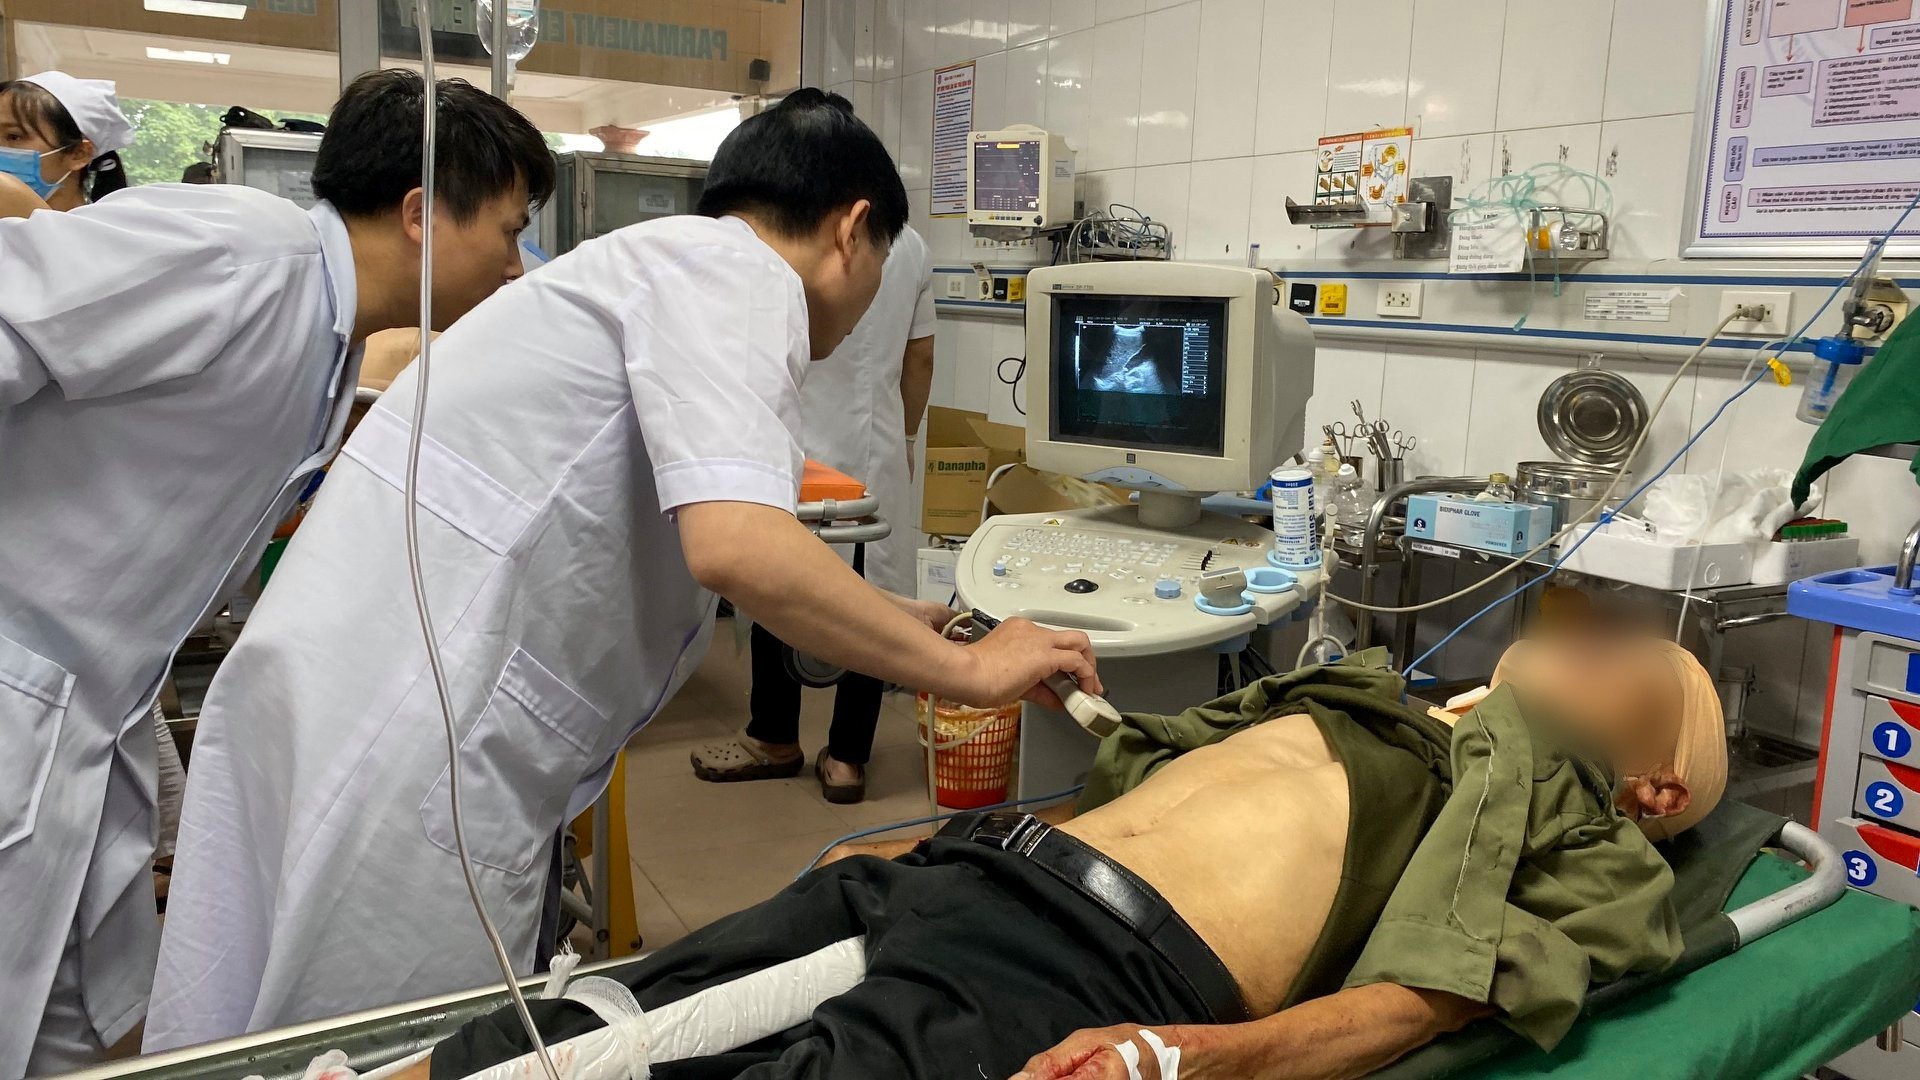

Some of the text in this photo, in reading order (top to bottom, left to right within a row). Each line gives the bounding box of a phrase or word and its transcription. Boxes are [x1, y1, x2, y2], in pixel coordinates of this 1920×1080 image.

[938, 461, 986, 472] Danapha
[1464, 509, 1480, 517] GLOVE
[1885, 729, 1898, 751] 1
[1874, 788, 1895, 813] 2
[1848, 857, 1868, 881] 3
